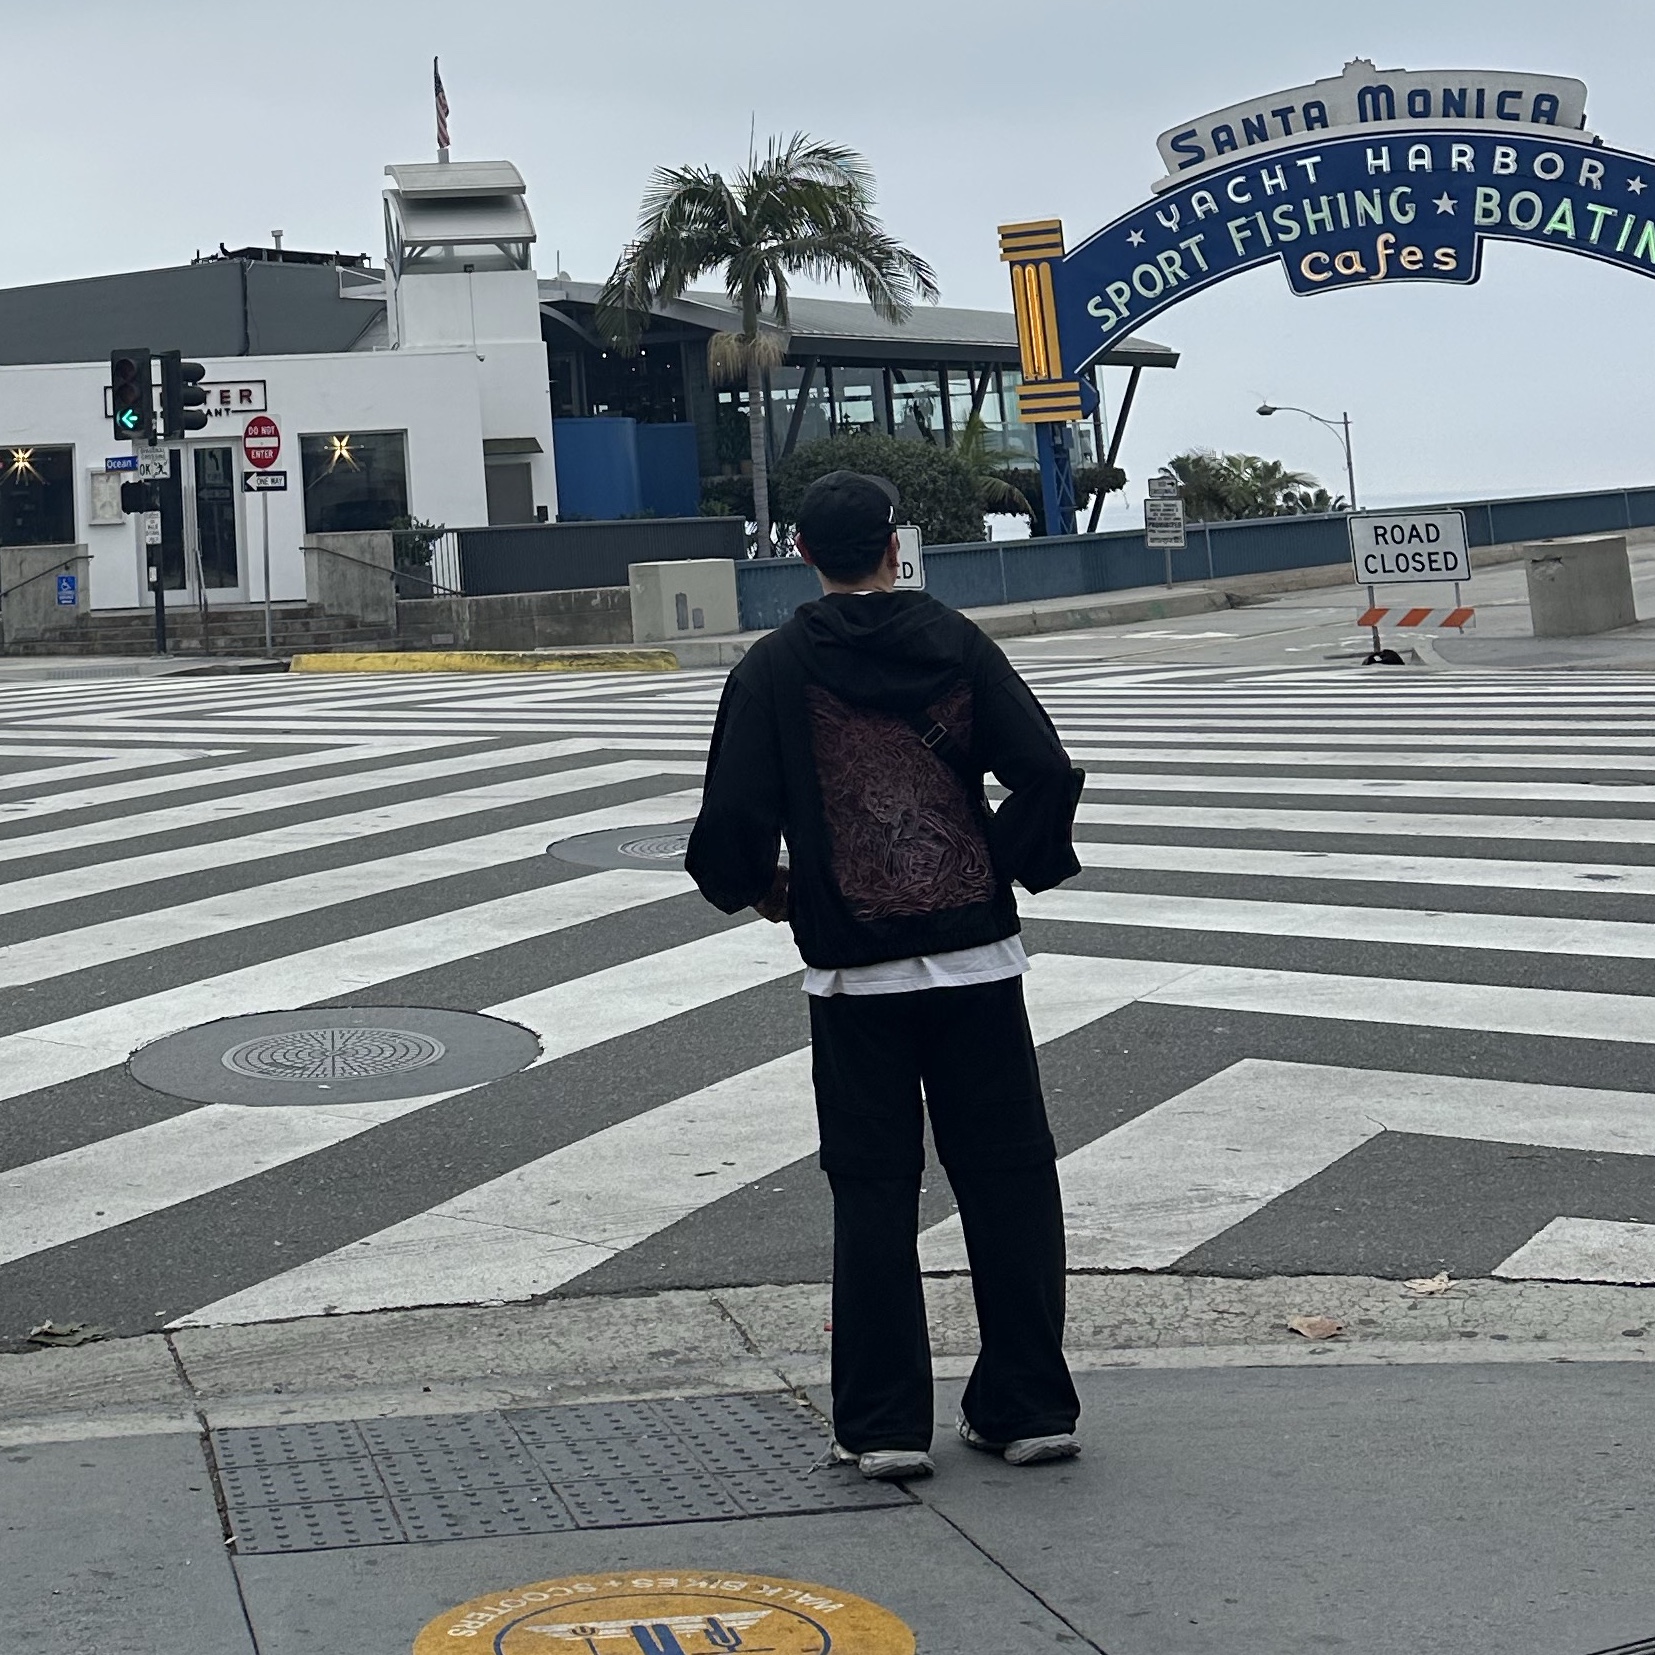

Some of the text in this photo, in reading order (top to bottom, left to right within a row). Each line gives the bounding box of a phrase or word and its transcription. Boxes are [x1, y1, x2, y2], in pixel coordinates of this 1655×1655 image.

[1170, 84, 1560, 170] SANTA MONICA
[1155, 143, 1605, 233] YACHT HARBOR
[1087, 233, 1209, 333] SPORT
[1226, 186, 1416, 257] FISHING
[1300, 232, 1458, 281] cafes
[248, 425, 275, 436] DO NOT
[107, 459, 132, 469] Ocean
[251, 449, 274, 460] ENTER
[140, 463, 151, 476] OK
[256, 476, 283, 486] ONE WAY
[1373, 523, 1441, 546] ROAD
[1364, 550, 1459, 575] CLOSED
[632, 1577, 748, 1591] BIKES
[447, 1582, 597, 1637] SCOOTERS
[752, 1583, 844, 1613] WALK
